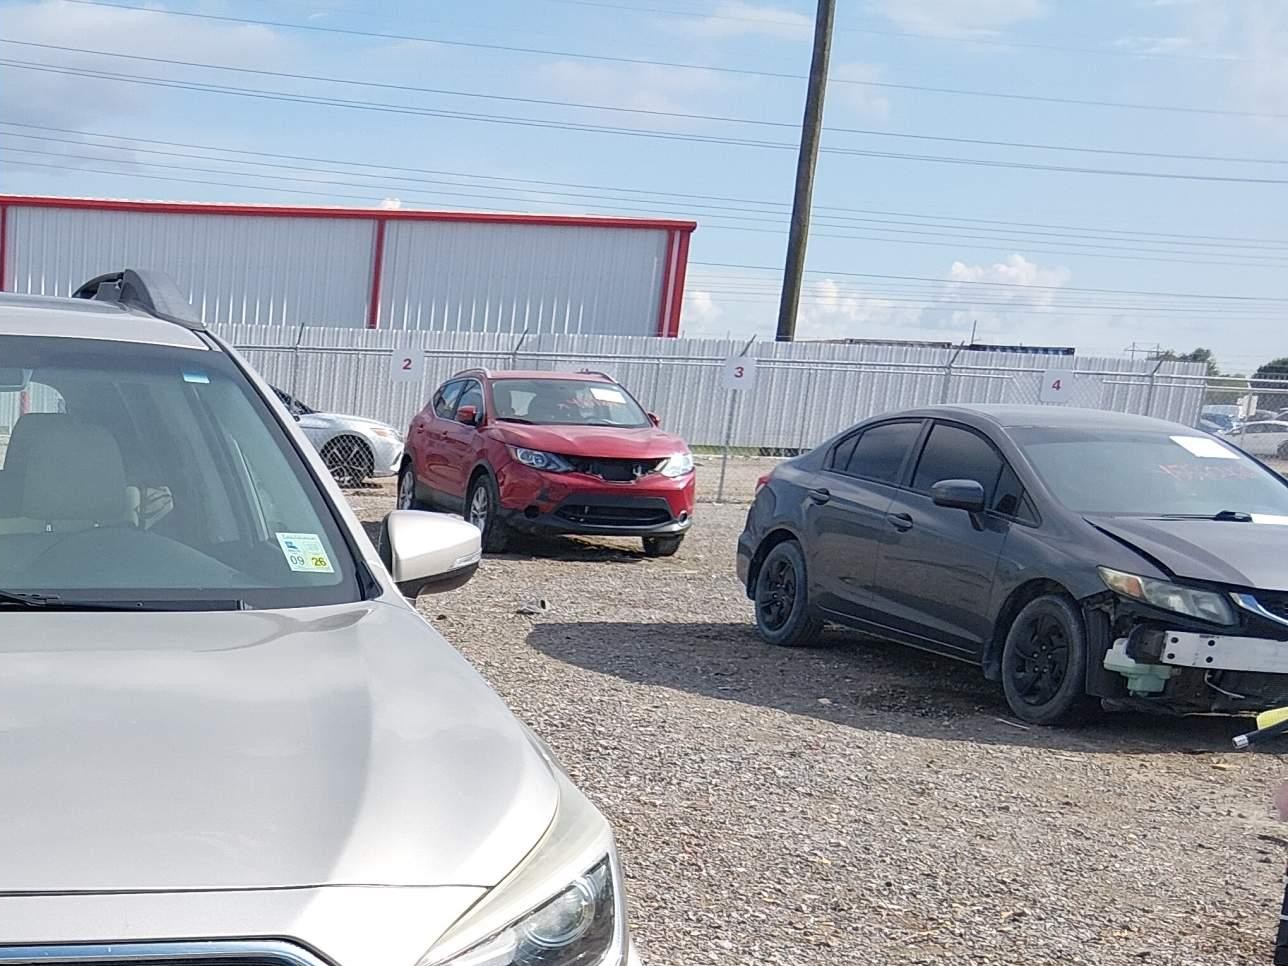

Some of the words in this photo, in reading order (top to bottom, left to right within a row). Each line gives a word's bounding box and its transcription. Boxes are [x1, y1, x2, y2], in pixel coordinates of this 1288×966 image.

[402, 358, 412, 370] 2
[734, 366, 744, 378] 3
[1051, 379, 1062, 391] 4
[290, 555, 305, 566] 09
[311, 557, 327, 567] 26
